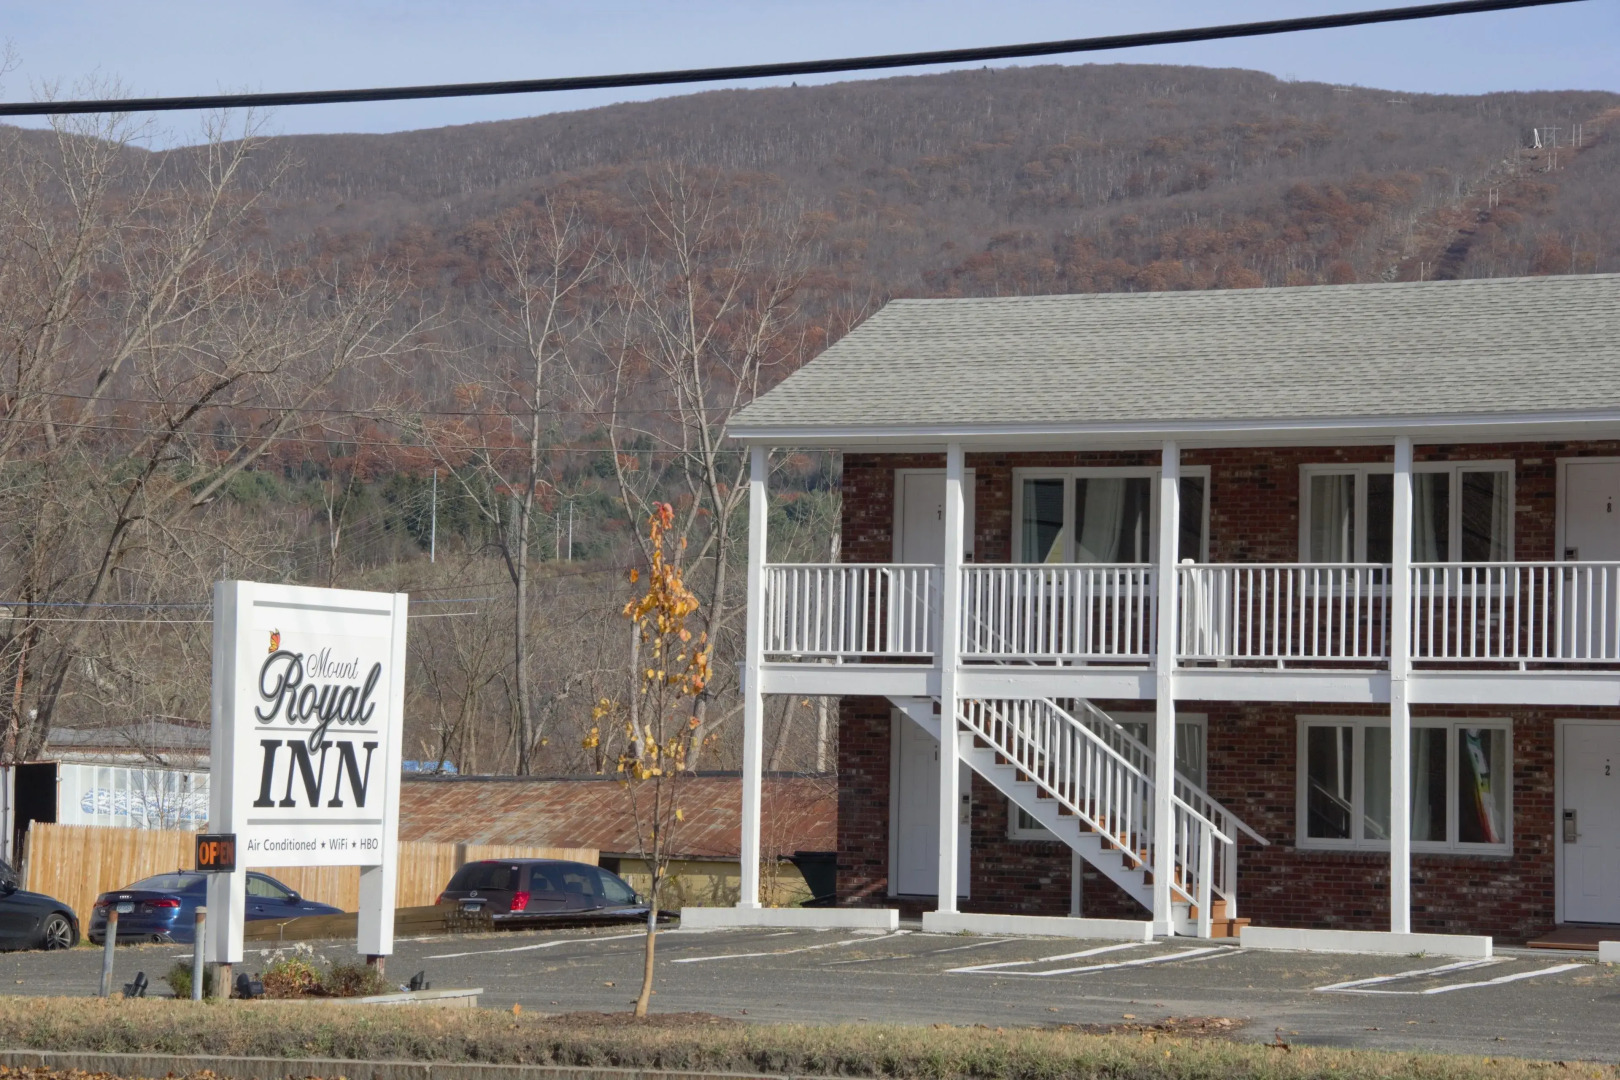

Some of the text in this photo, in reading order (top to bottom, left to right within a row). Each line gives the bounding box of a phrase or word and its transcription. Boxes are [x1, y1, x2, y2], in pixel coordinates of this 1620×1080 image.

[306, 647, 359, 680] Mount
[254, 650, 381, 756] Royal
[253, 739, 379, 808] INN
[1605, 765, 1611, 776] 2
[198, 841, 235, 865] OPEN
[247, 838, 379, 851] Air Conditioned WiFi HBO
